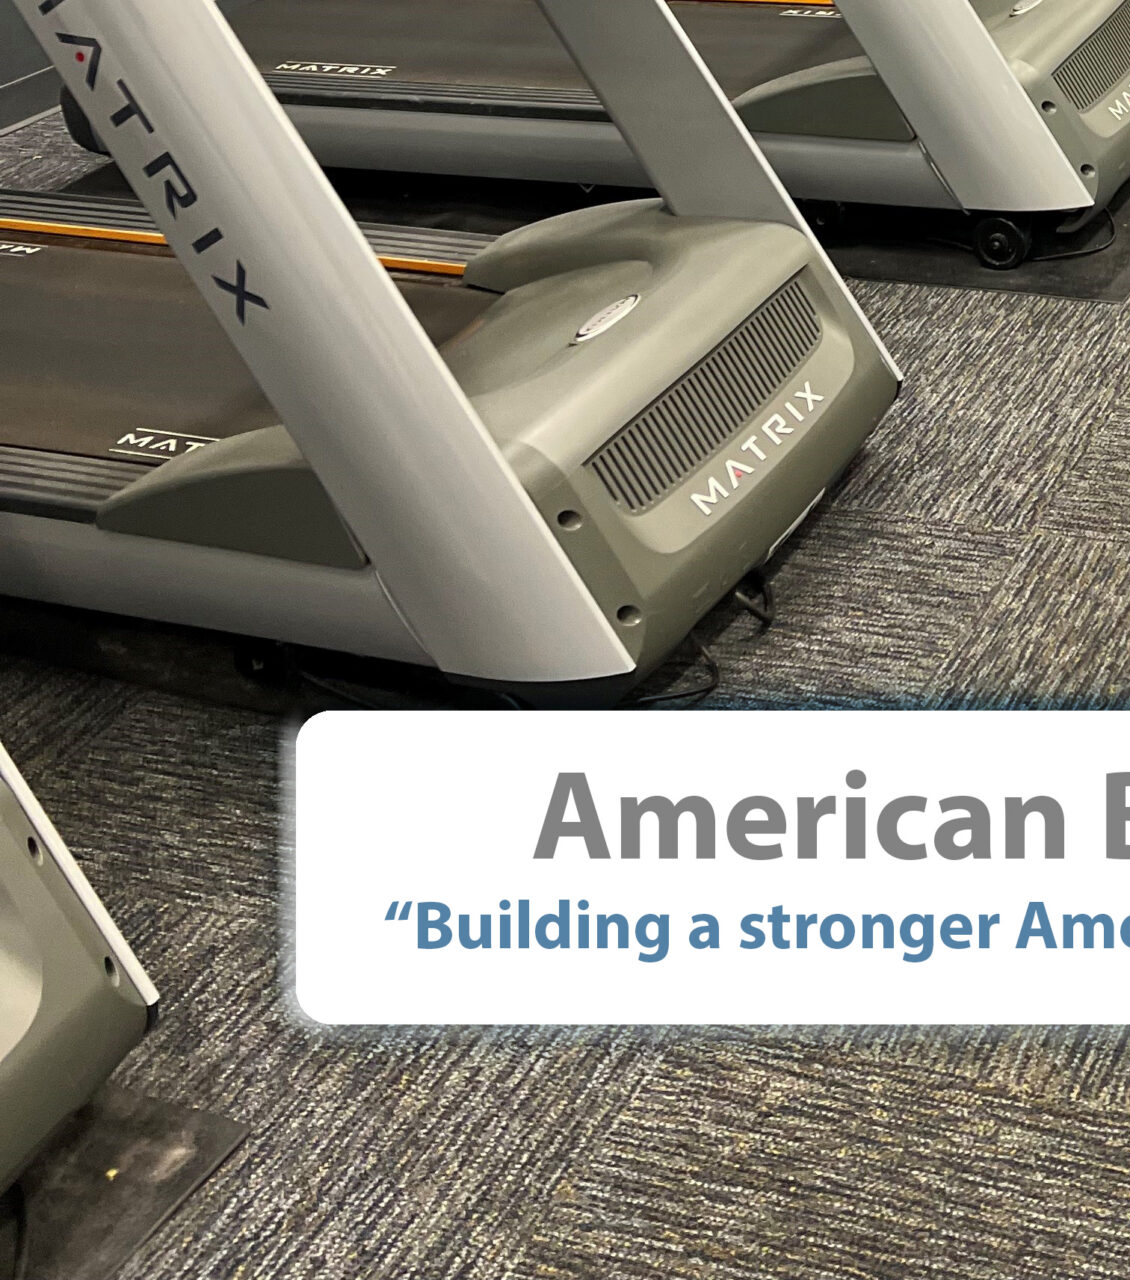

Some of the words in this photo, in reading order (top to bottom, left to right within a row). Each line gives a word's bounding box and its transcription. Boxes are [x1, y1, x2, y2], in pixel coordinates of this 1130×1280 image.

[275, 63, 393, 76] MATRIX
[117, 433, 206, 454] MAT
[690, 381, 825, 517] MATRIX
